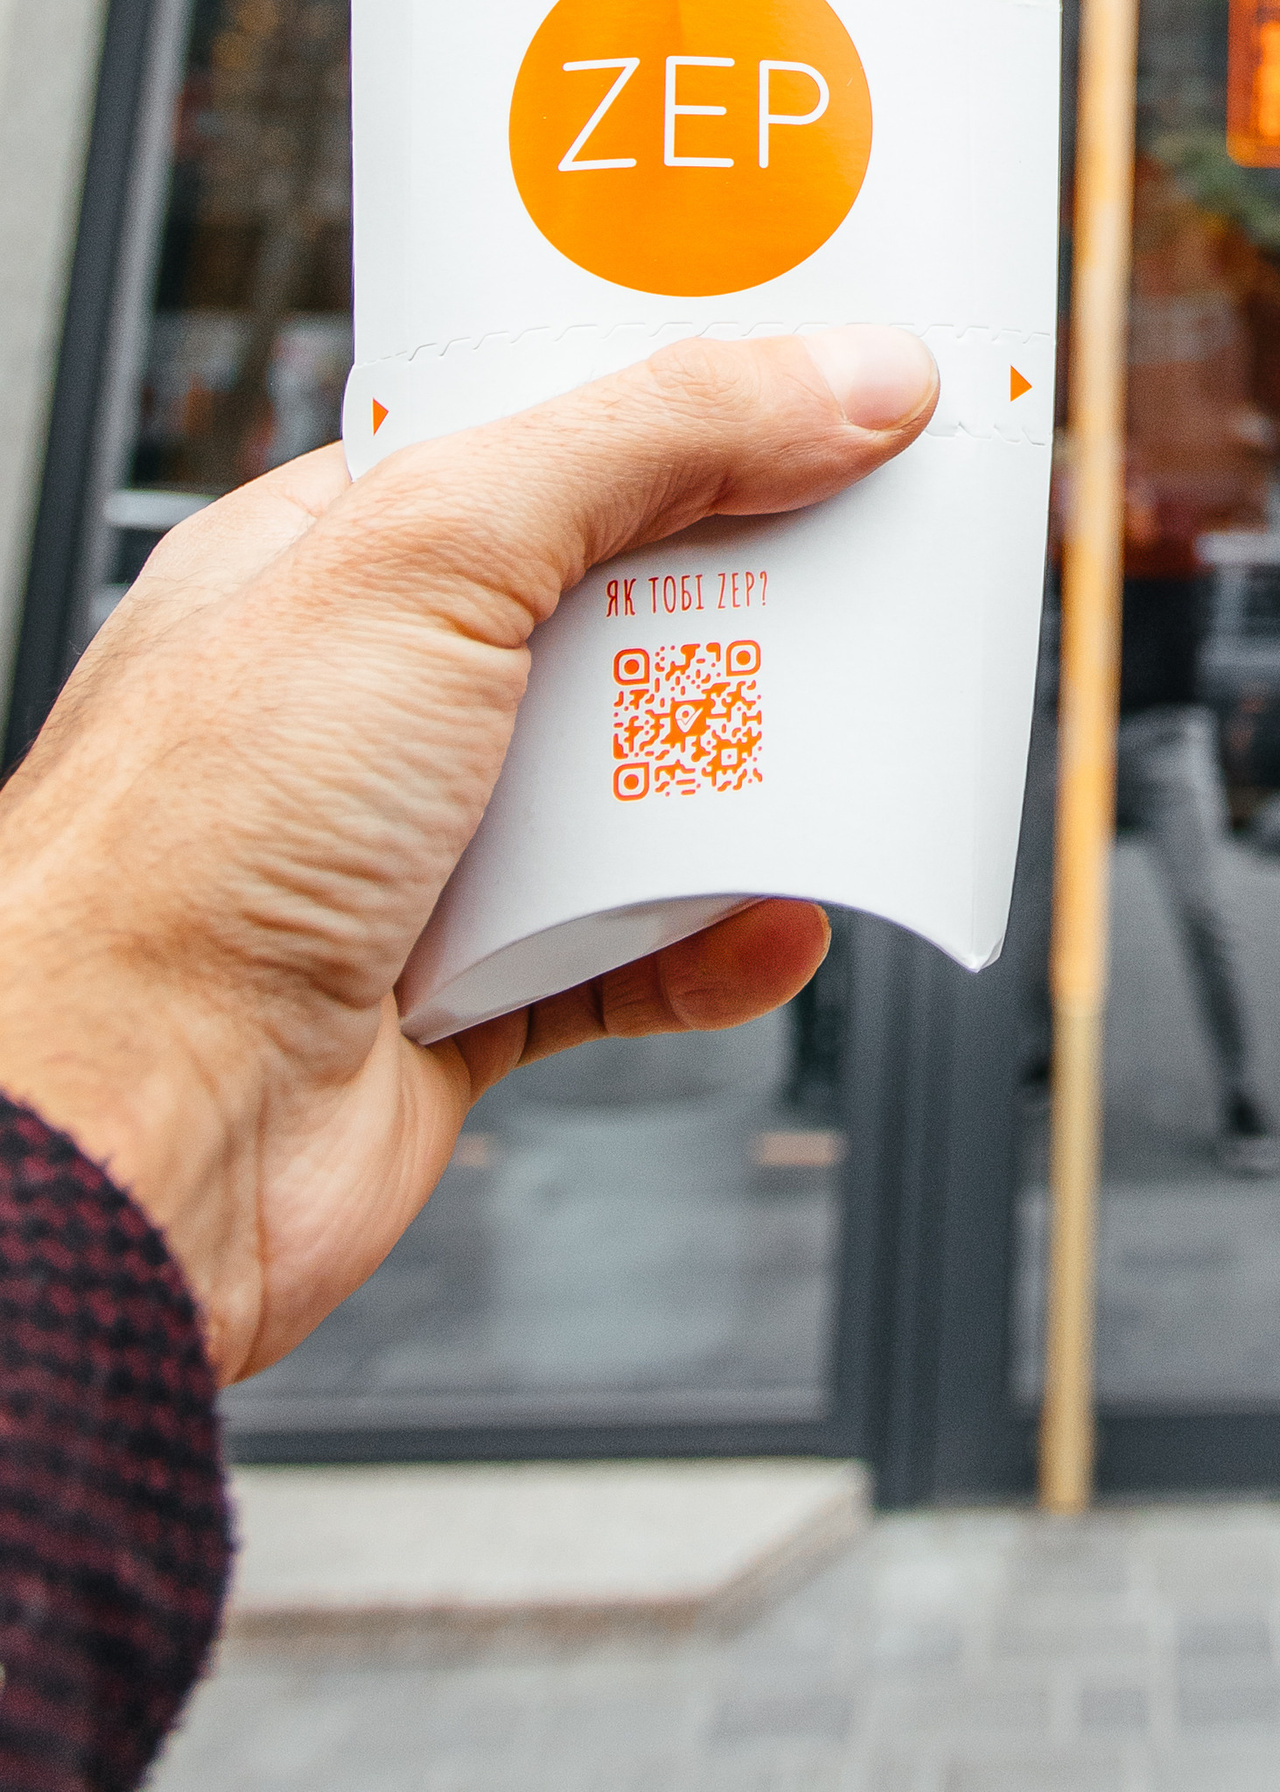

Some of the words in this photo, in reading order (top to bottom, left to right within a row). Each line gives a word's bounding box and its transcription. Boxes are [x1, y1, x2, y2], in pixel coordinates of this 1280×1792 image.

[557, 55, 830, 172] ZEP
[605, 578, 637, 618] ЯК
[648, 574, 704, 614] ТОБІ
[717, 570, 770, 610] ZEP?
